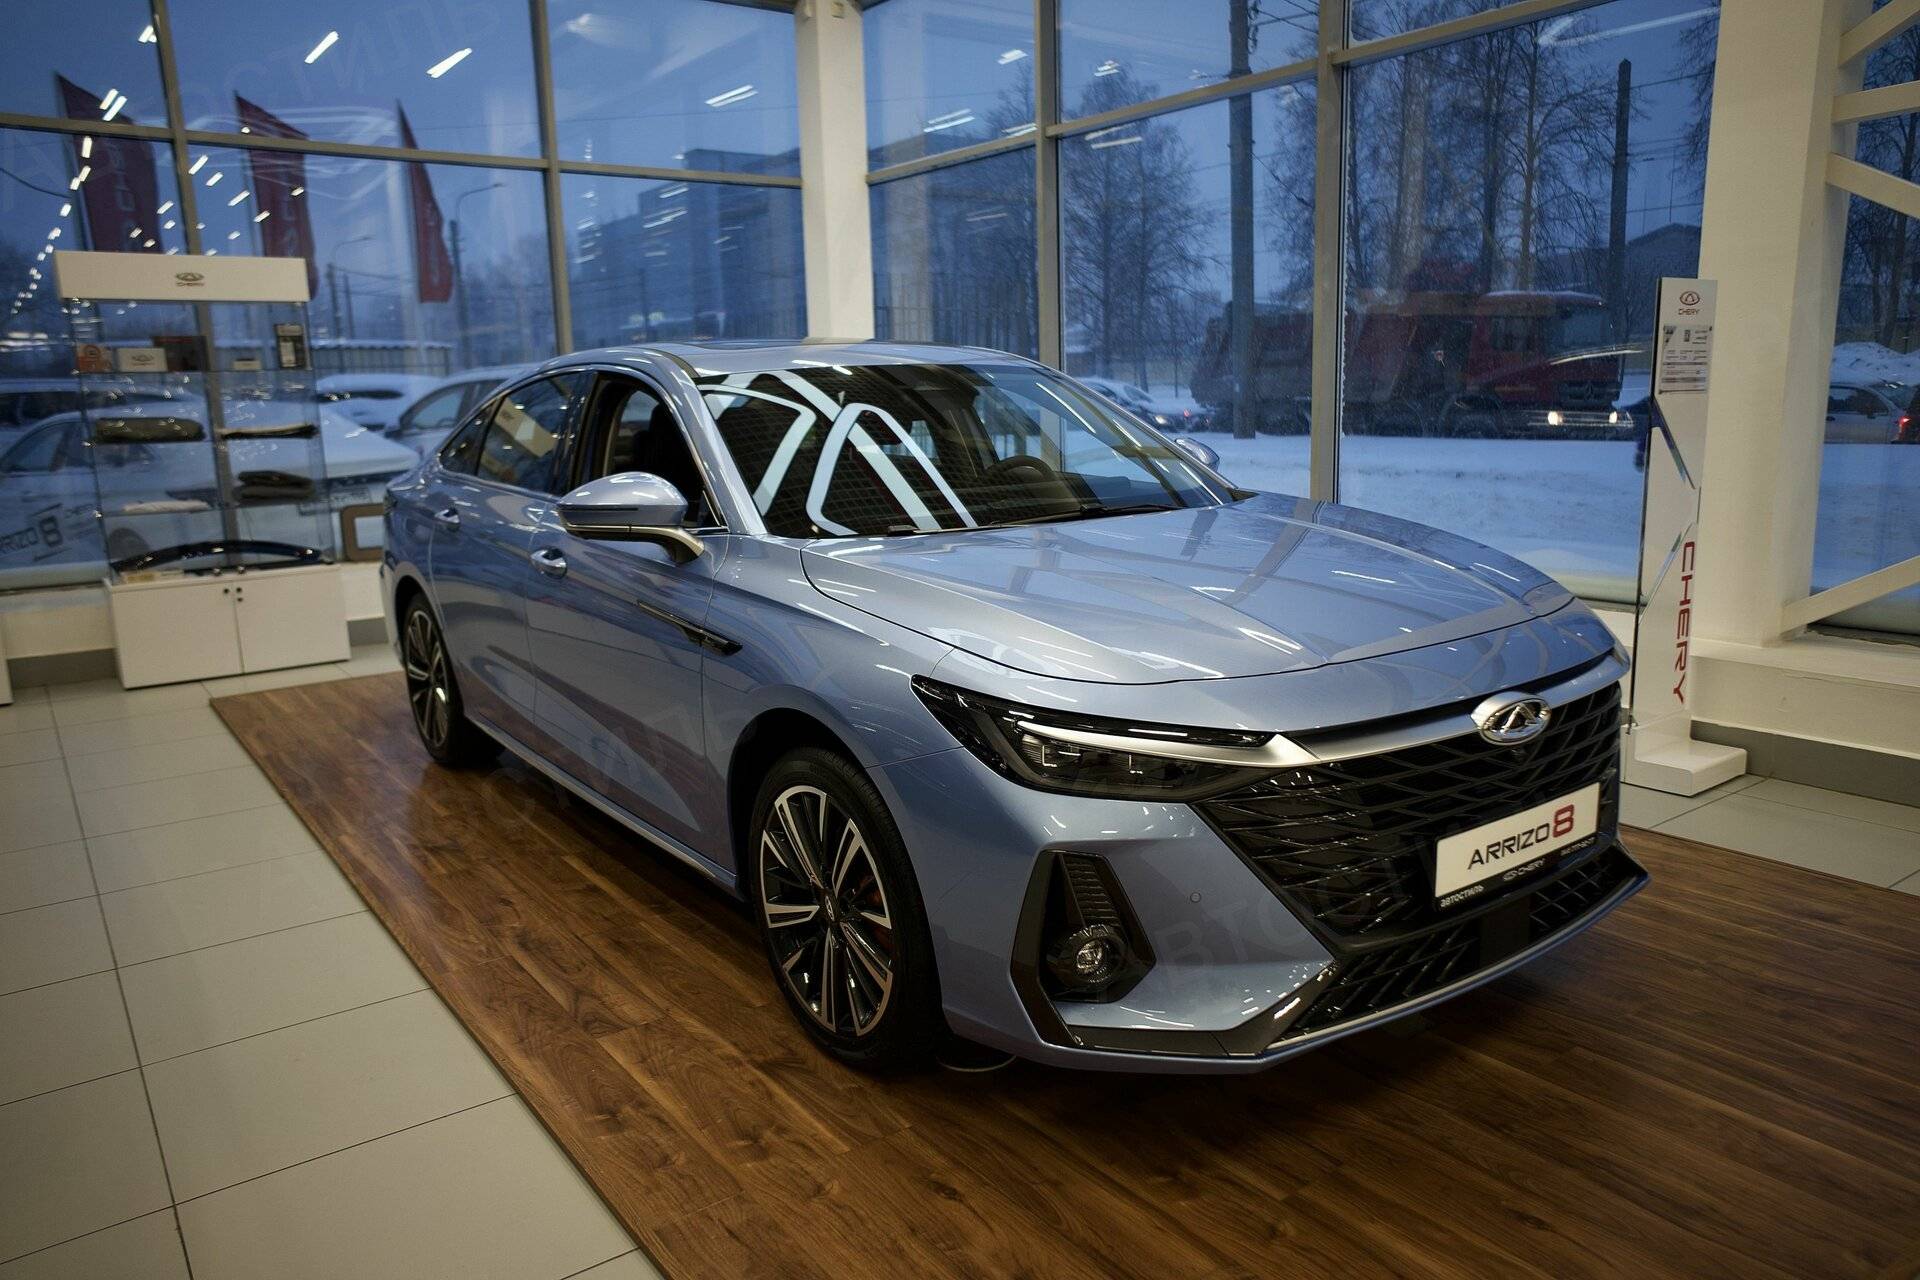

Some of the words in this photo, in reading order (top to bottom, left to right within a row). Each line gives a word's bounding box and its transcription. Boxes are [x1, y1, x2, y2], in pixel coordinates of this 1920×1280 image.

[1678, 308, 1700, 316] CHERY
[39, 515, 64, 548] 8
[1673, 541, 1695, 704] CHERY
[1467, 822, 1550, 870] ARRIZO
[1552, 804, 1575, 838] 8
